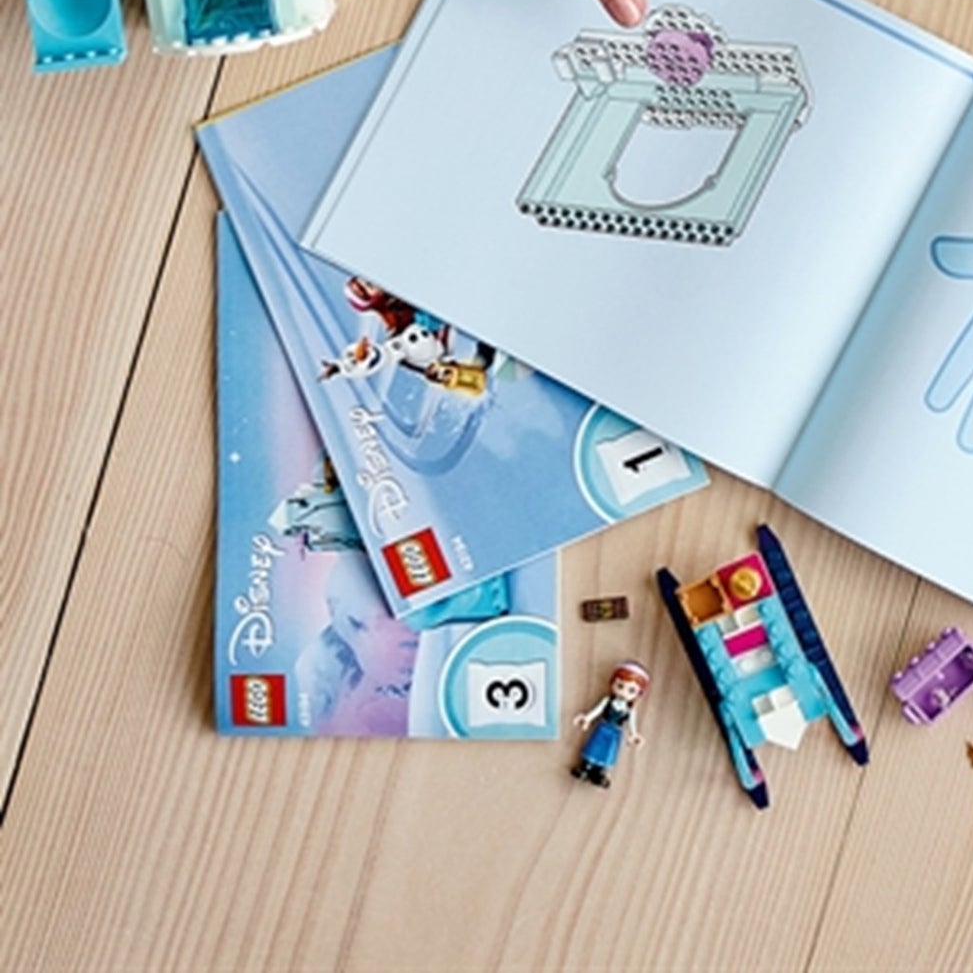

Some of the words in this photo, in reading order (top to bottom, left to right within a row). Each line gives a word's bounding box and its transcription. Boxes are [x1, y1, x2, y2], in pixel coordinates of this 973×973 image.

[623, 444, 664, 474] 1
[395, 538, 438, 587] LEGO
[244, 676, 271, 725] LEGO
[485, 678, 530, 710] 3
